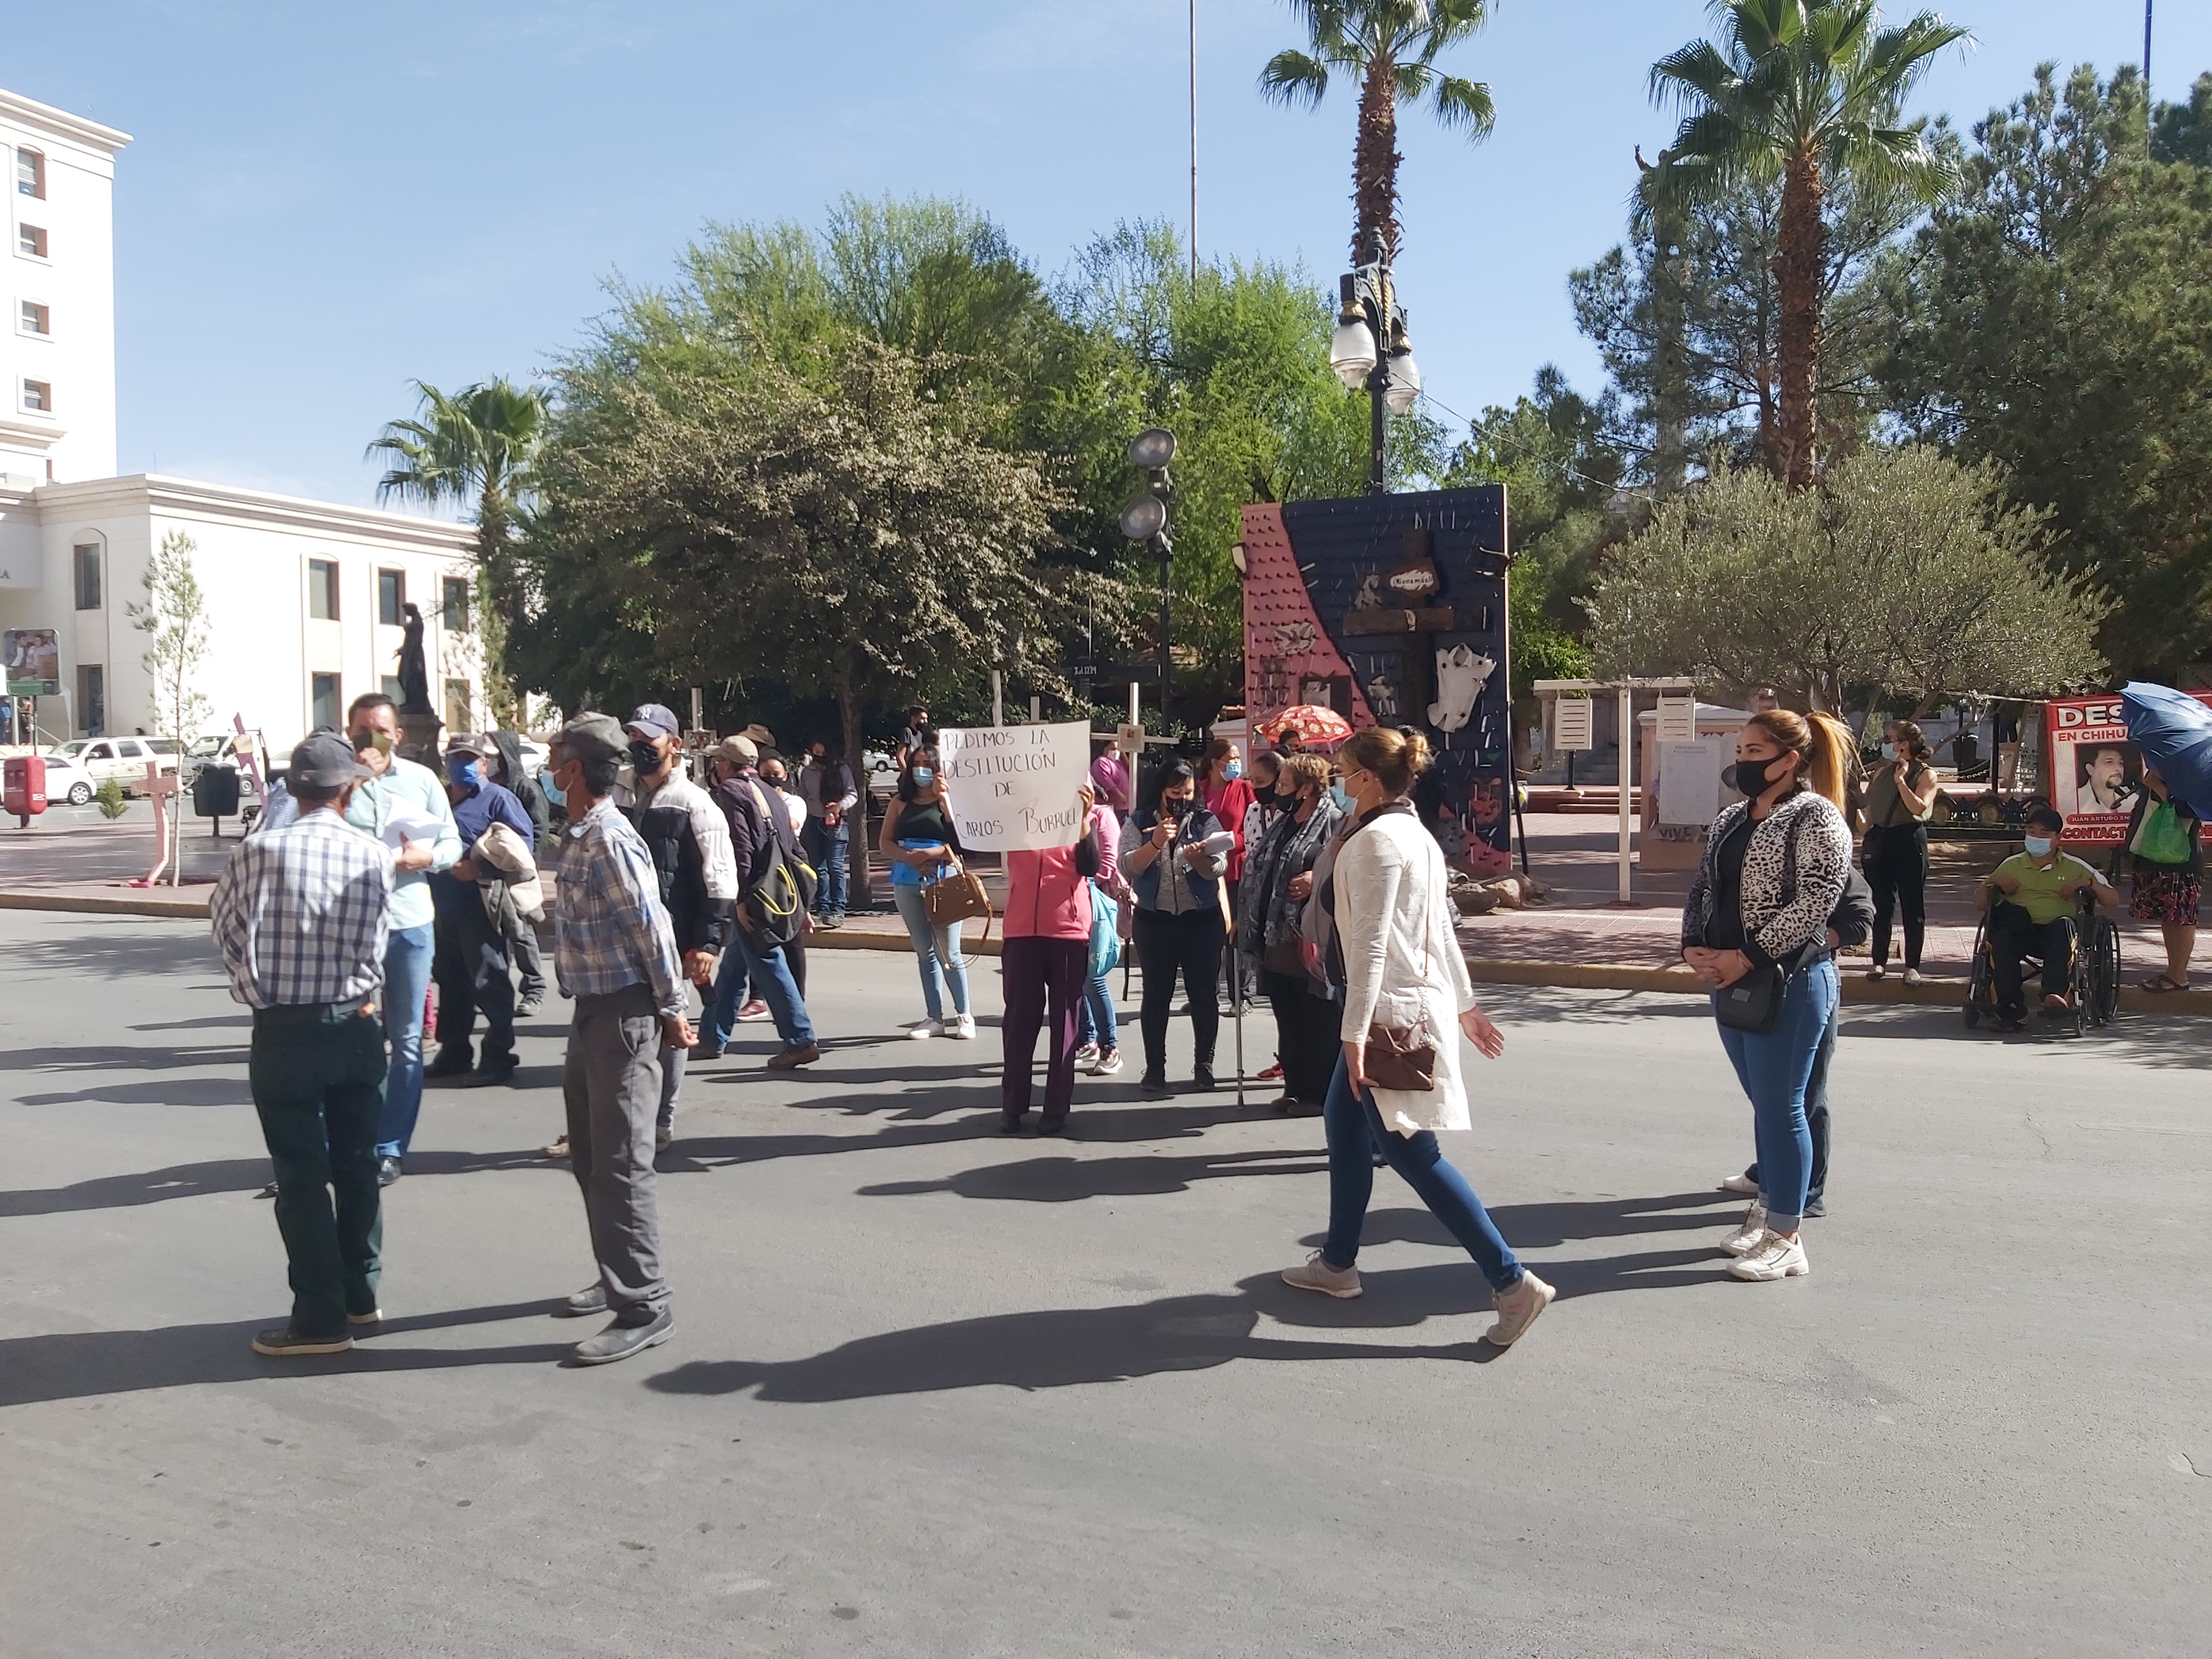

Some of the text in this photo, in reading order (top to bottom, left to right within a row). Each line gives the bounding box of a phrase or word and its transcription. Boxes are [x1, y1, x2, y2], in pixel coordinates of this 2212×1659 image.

[943, 729, 1051, 752] PEDIMOS LA
[2058, 729, 2126, 742] EN CHIHU
[943, 747, 1056, 780] DESTITUCIÓN
[991, 781, 1015, 798] DE
[955, 807, 1078, 839] CARLOS BURRUEL
[2063, 826, 2126, 839] CONTACT
